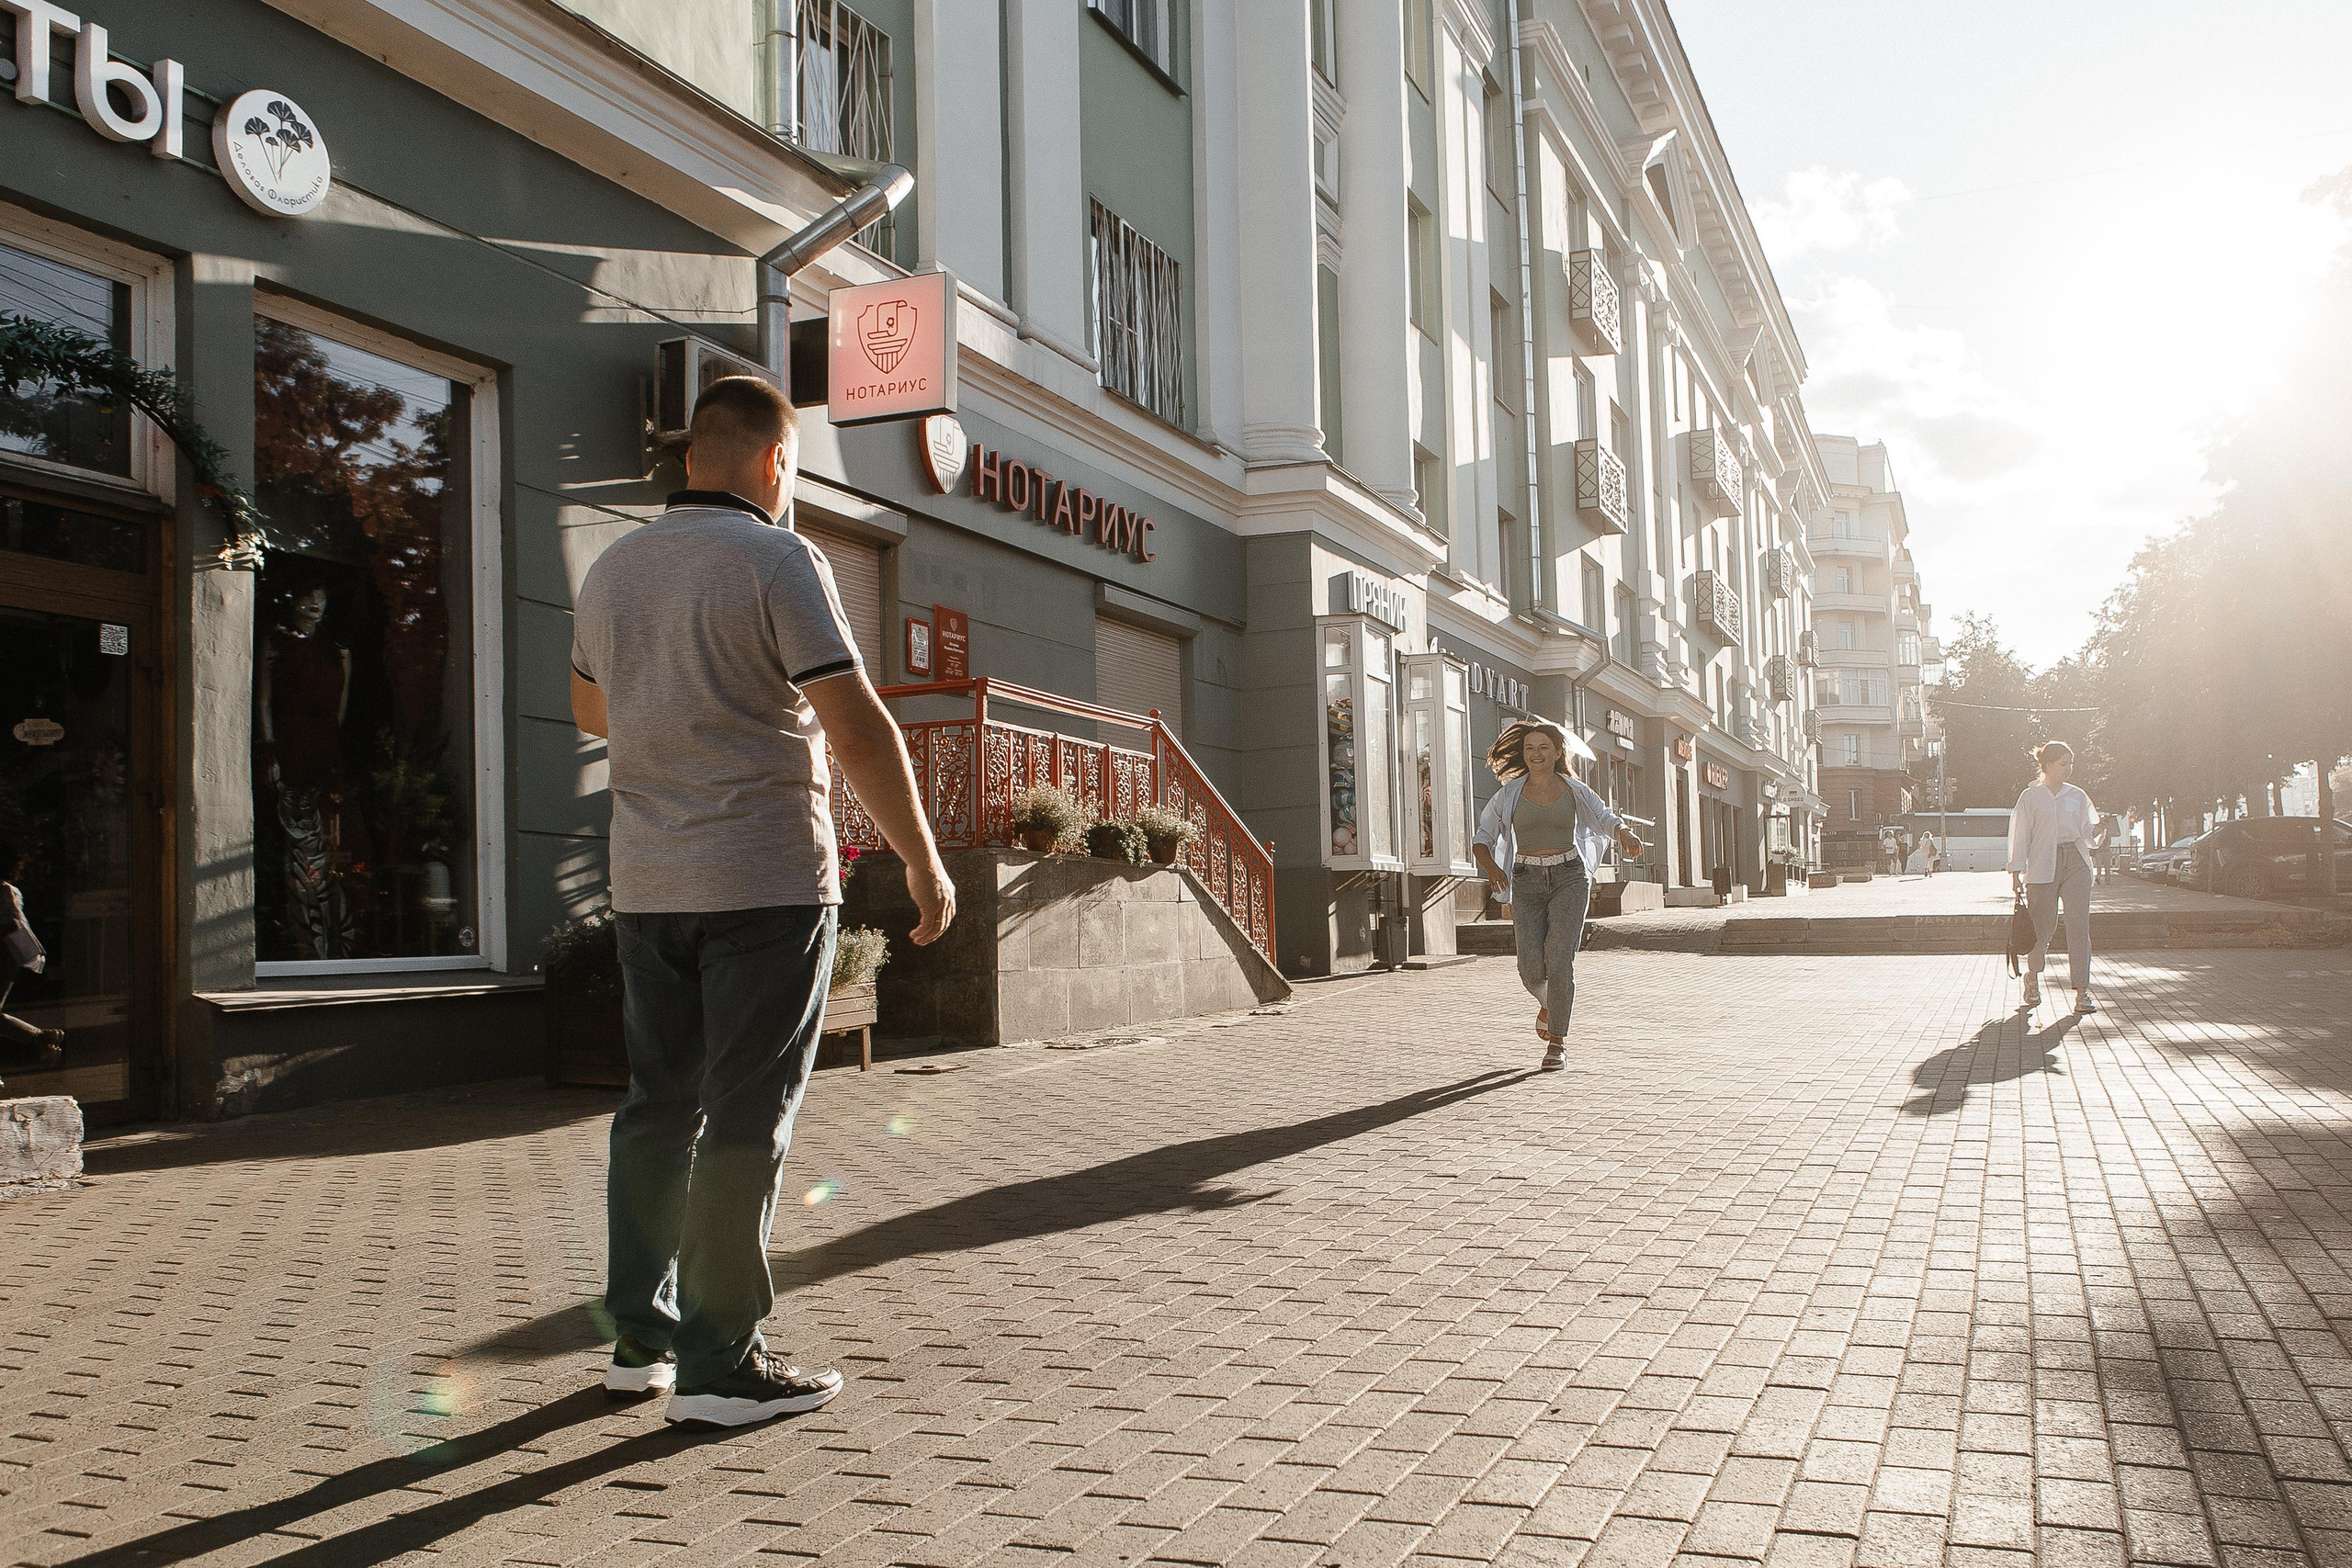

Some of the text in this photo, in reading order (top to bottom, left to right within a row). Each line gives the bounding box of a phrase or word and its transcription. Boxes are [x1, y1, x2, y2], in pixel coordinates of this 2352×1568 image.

[0, 0, 184, 160] ТЫ
[233, 141, 323, 209] Деловая Флористика
[846, 377, 928, 401] НОТАРИУС
[972, 443, 1157, 563] НОТАРИУС
[1349, 570, 1407, 633] ПРЯНИК
